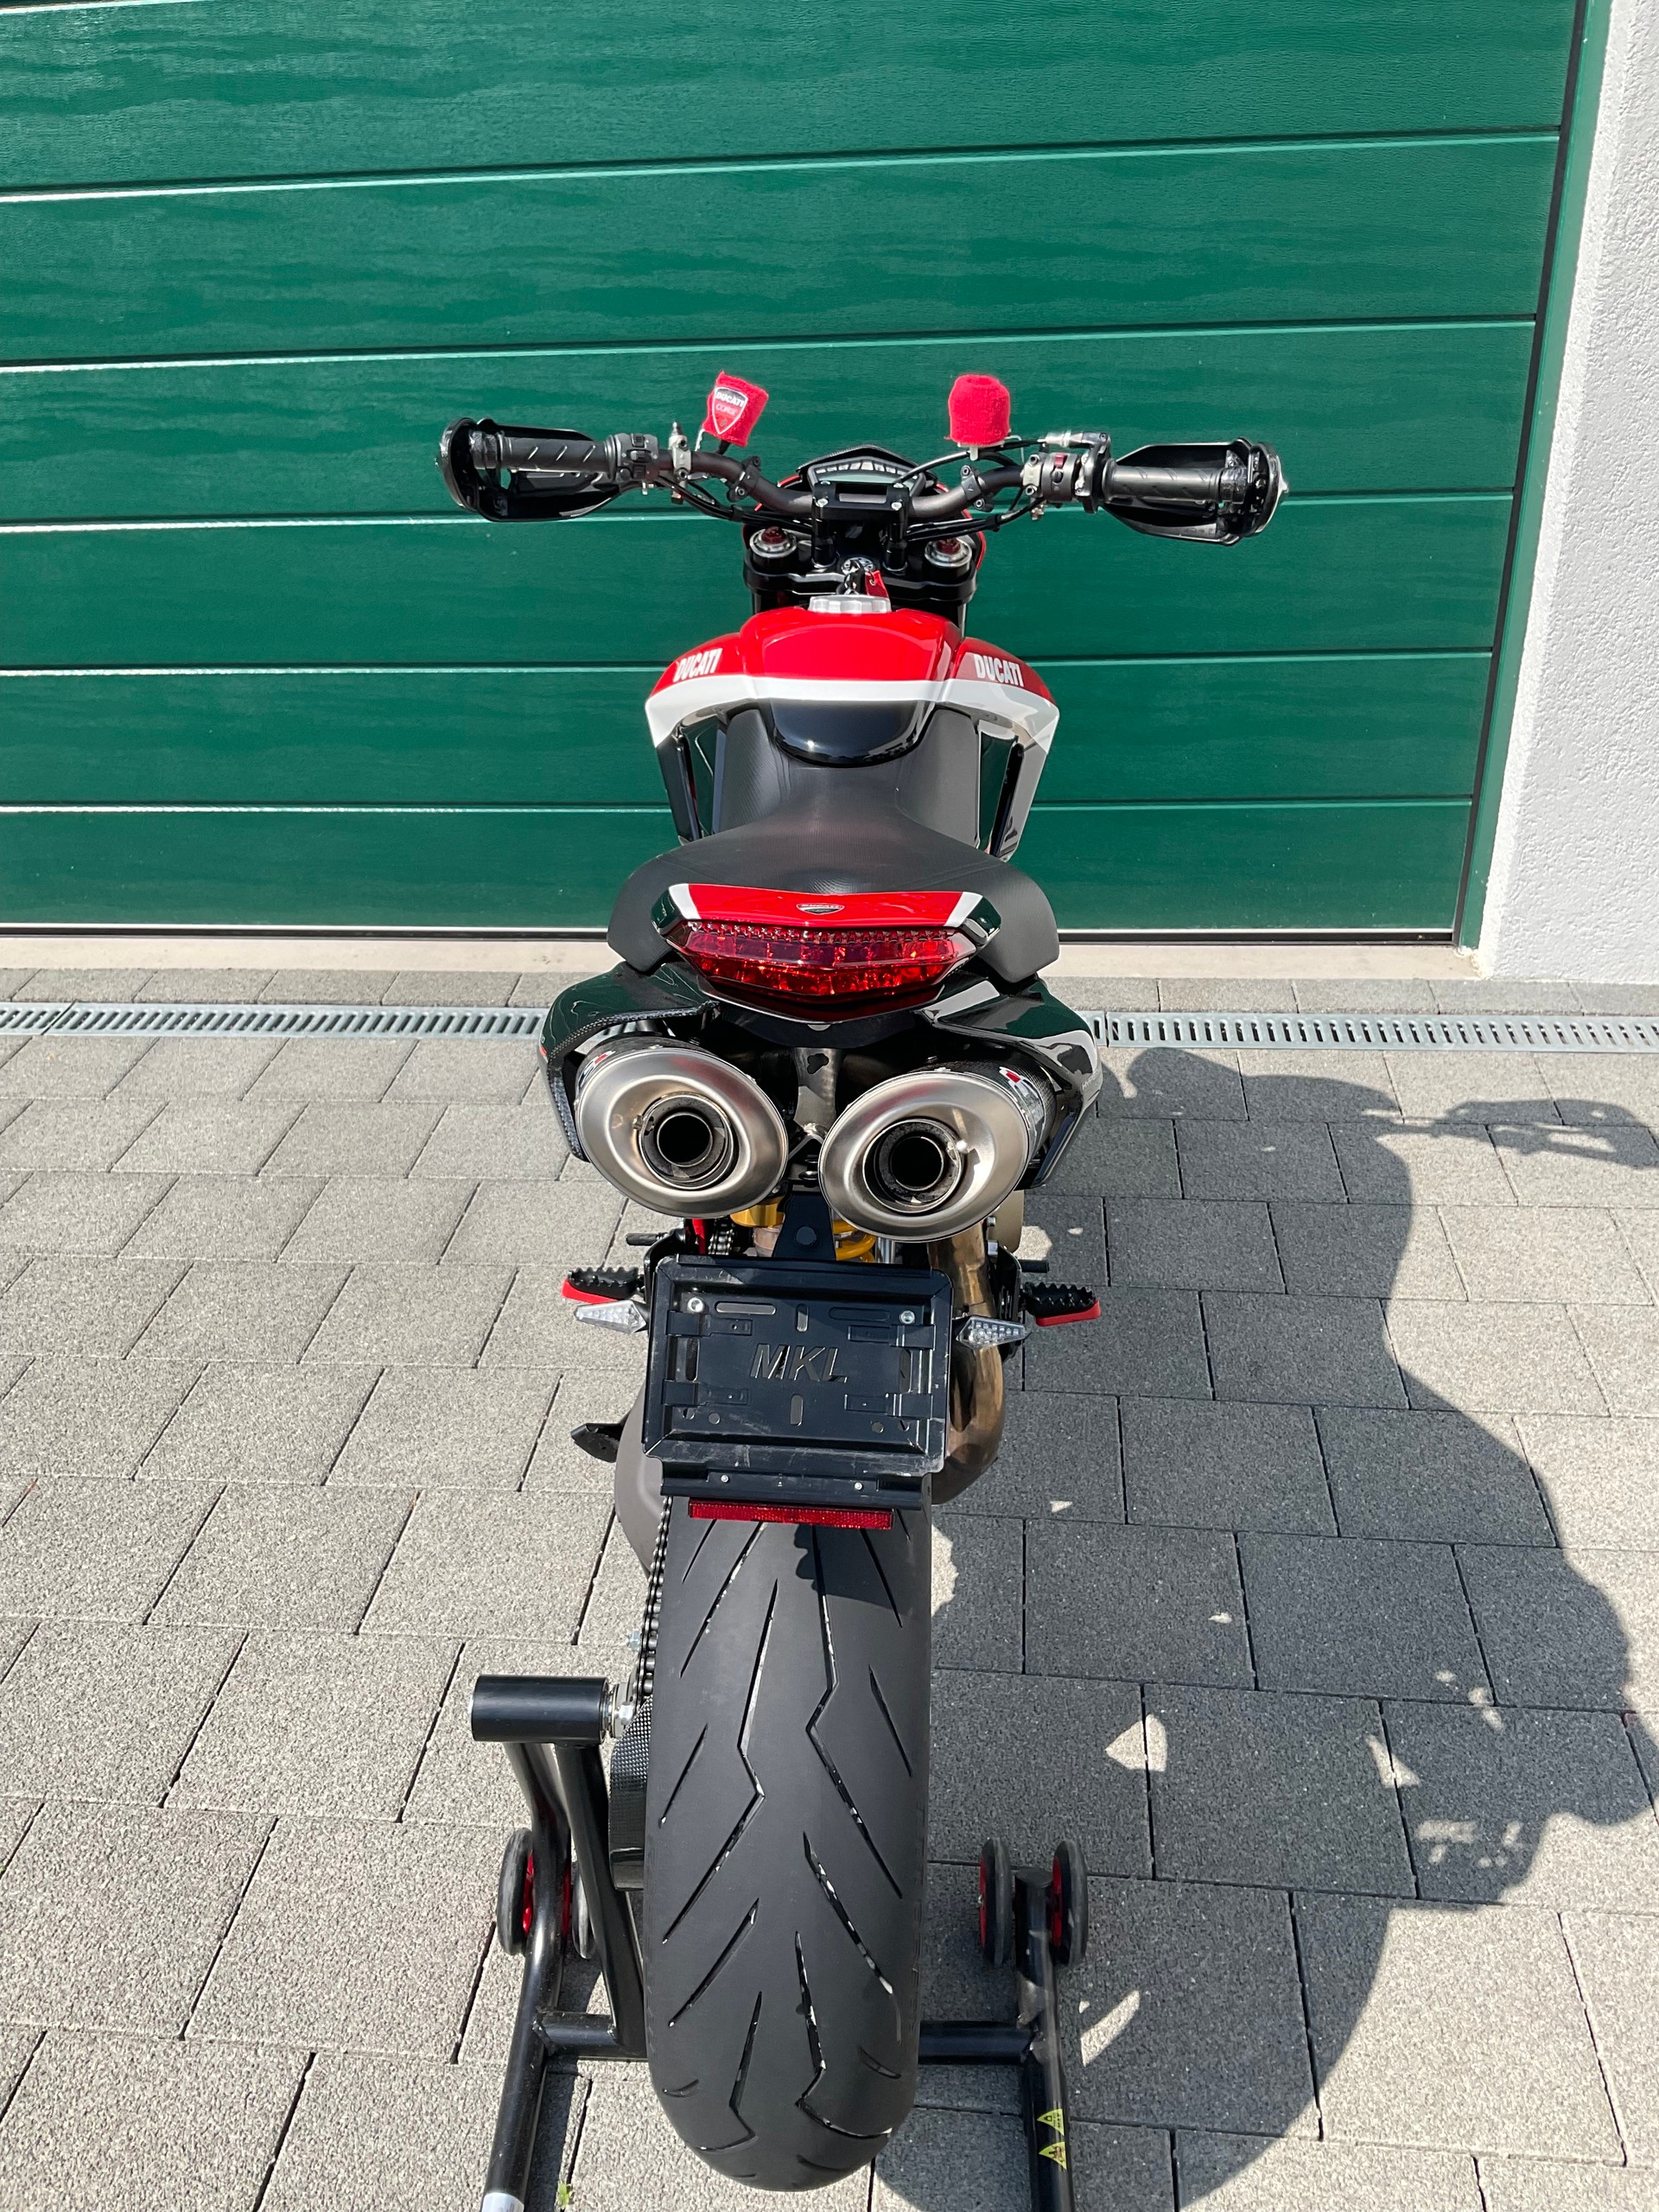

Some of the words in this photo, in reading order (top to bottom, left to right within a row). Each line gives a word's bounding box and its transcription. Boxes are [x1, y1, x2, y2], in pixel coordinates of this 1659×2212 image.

[715, 391, 745, 408] DUCATI
[673, 648, 723, 683] DUCATI
[973, 653, 1024, 687] DUCATI
[750, 1343, 848, 1382] MKL
